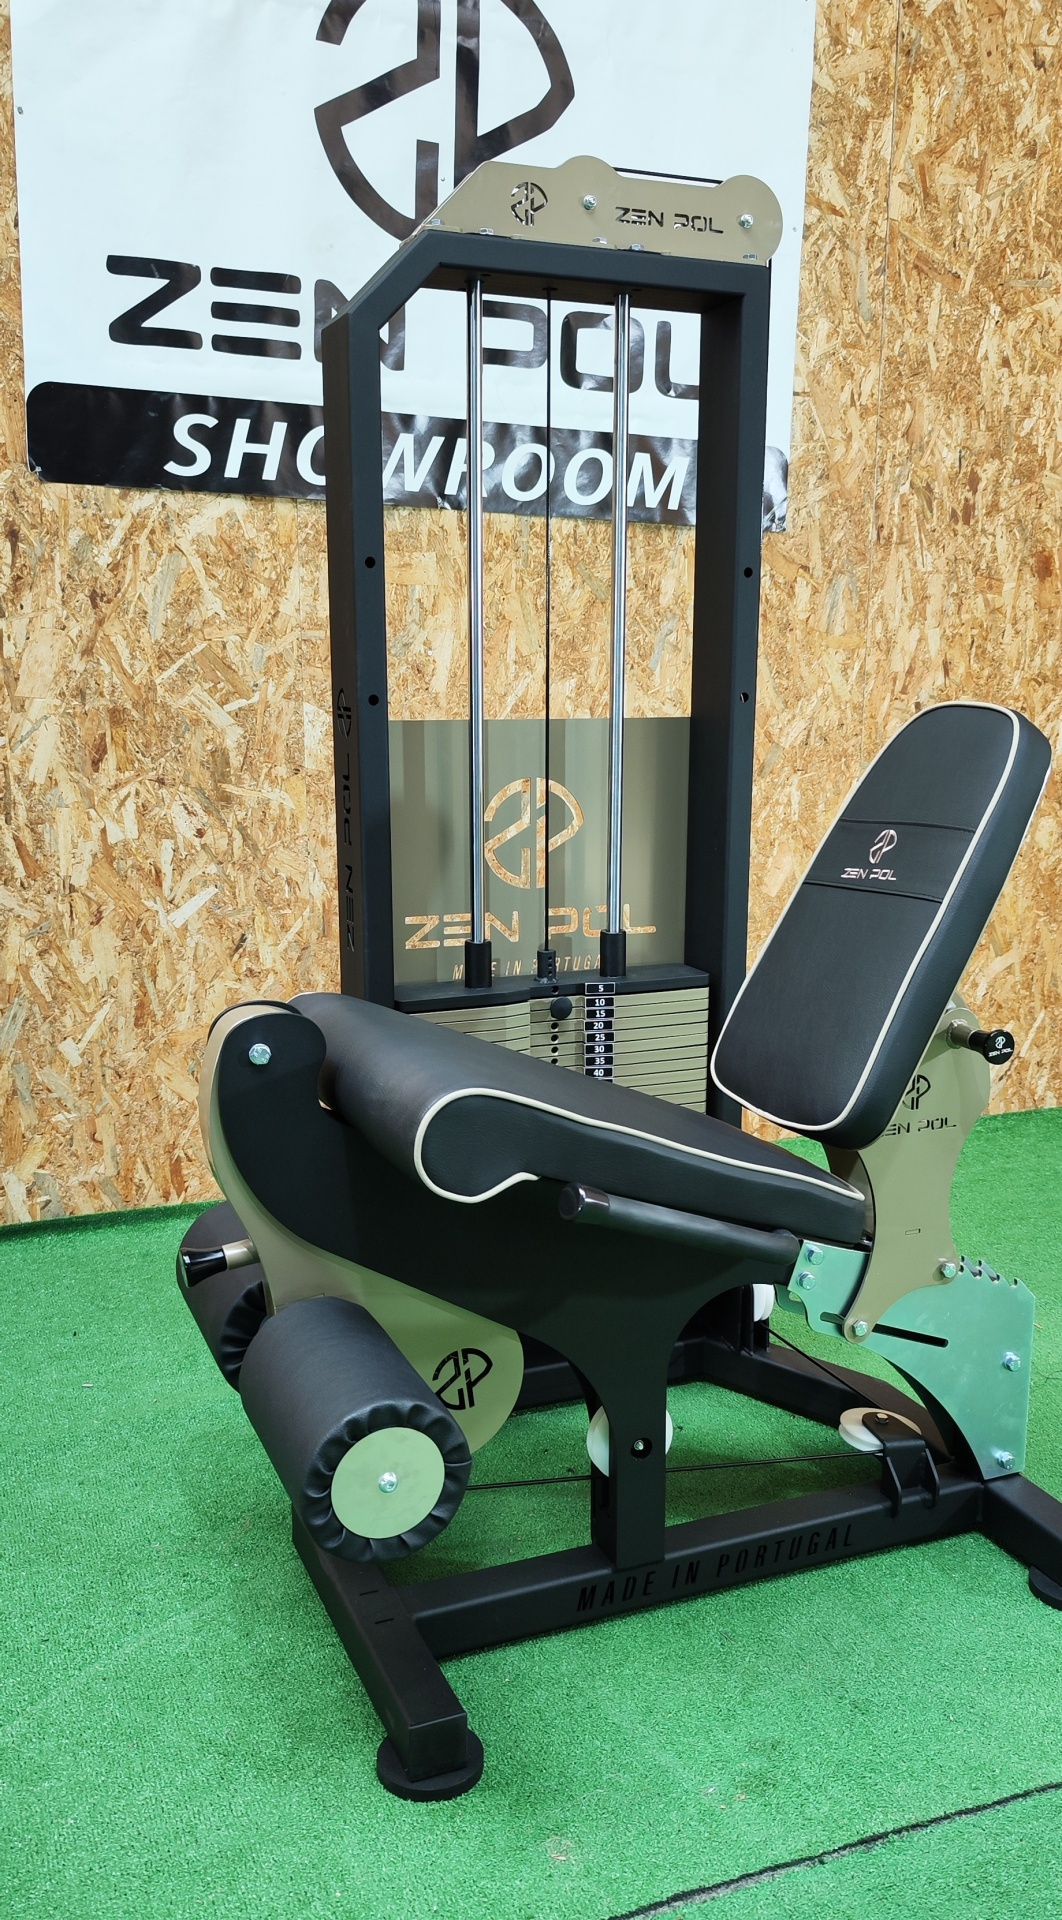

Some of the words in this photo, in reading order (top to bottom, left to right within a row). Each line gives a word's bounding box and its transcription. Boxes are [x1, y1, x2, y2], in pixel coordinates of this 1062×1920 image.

[614, 206, 664, 227] ZEN
[674, 213, 724, 234] POL
[841, 867, 868, 879] ZEN
[869, 868, 897, 880] POL
[404, 910, 519, 949] ZEN
[594, 998, 606, 1006] 10
[595, 1010, 606, 1018] 15
[593, 1021, 604, 1030] 20
[594, 1033, 606, 1041] 25
[593, 1045, 605, 1053] 30
[594, 1057, 605, 1065] 35
[593, 1068, 604, 1077] 40
[880, 1121, 911, 1138] EN
[917, 1116, 957, 1132] POL
[576, 1570, 657, 1612] MADE
[671, 1559, 700, 1590] IN
[716, 1523, 853, 1579] PORTUGAL
